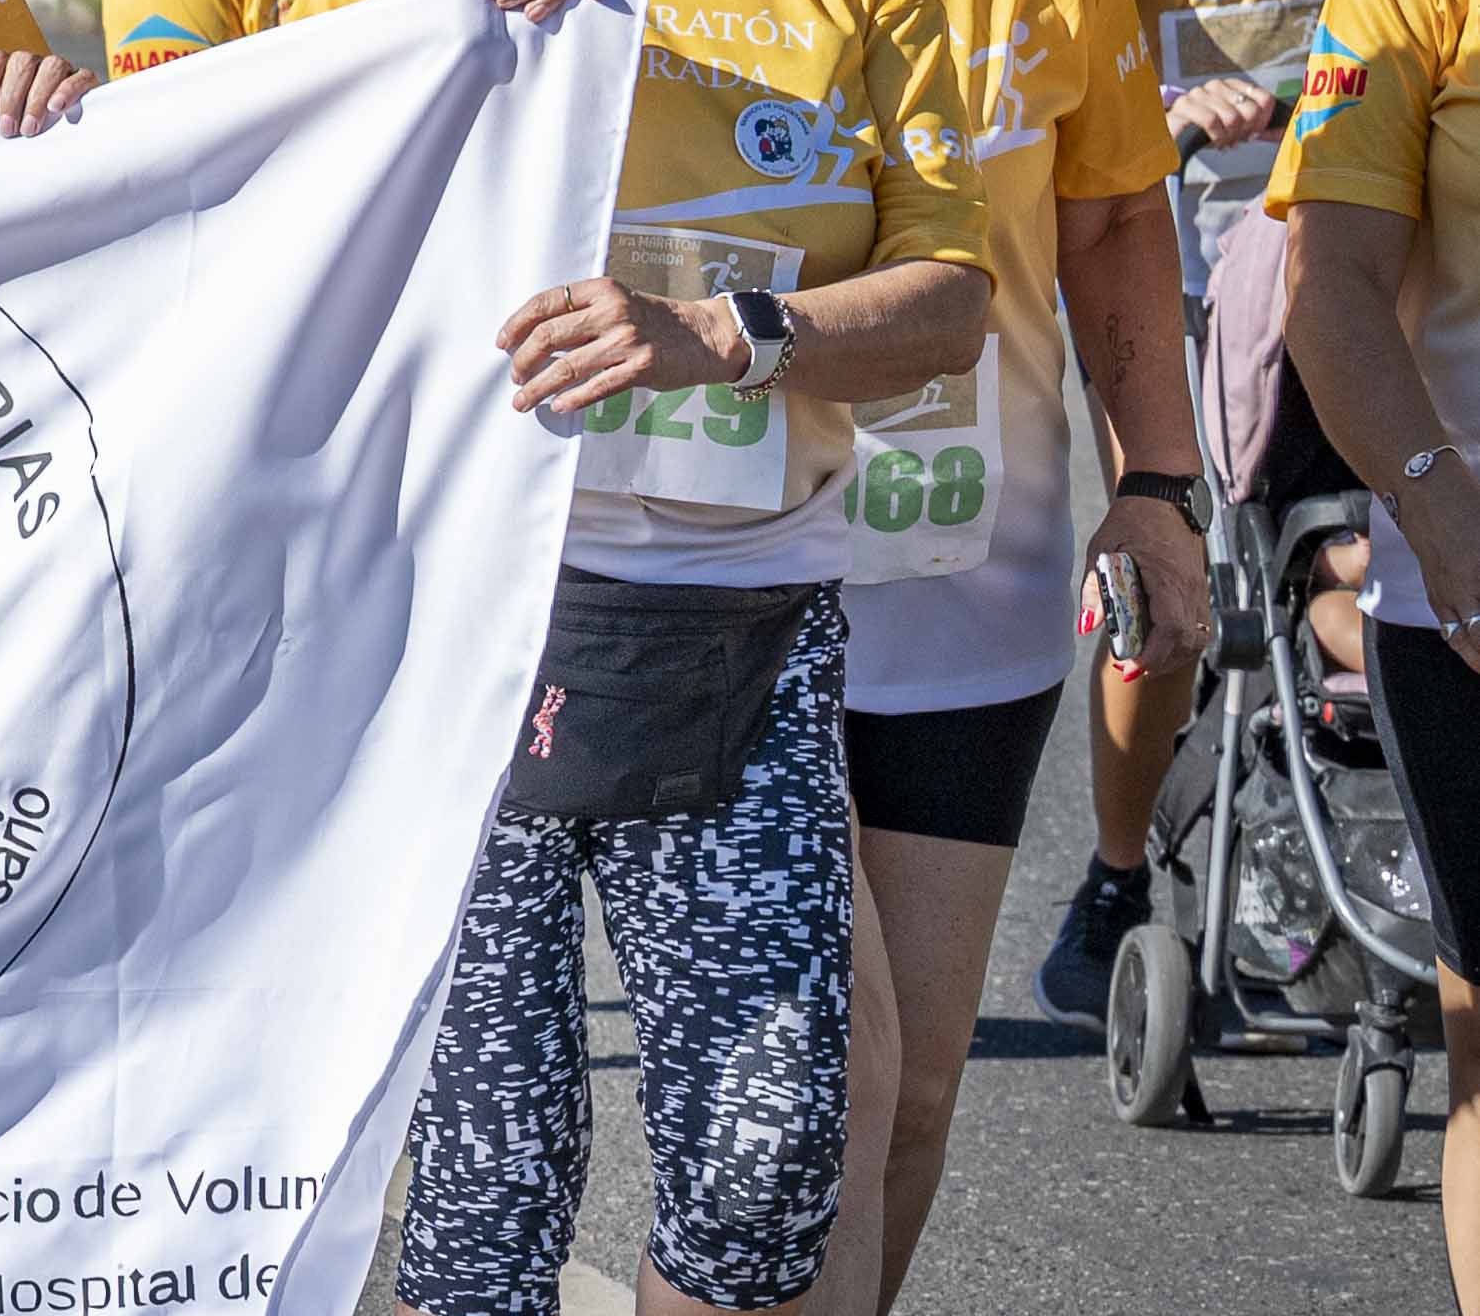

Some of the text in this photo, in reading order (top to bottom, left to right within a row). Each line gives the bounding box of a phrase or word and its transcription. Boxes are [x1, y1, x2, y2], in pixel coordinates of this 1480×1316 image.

[646, 5, 816, 52] RATÓN
[844, 446, 985, 533] 68
[74, 1170, 141, 1219] de
[166, 1165, 326, 1215] Volun
